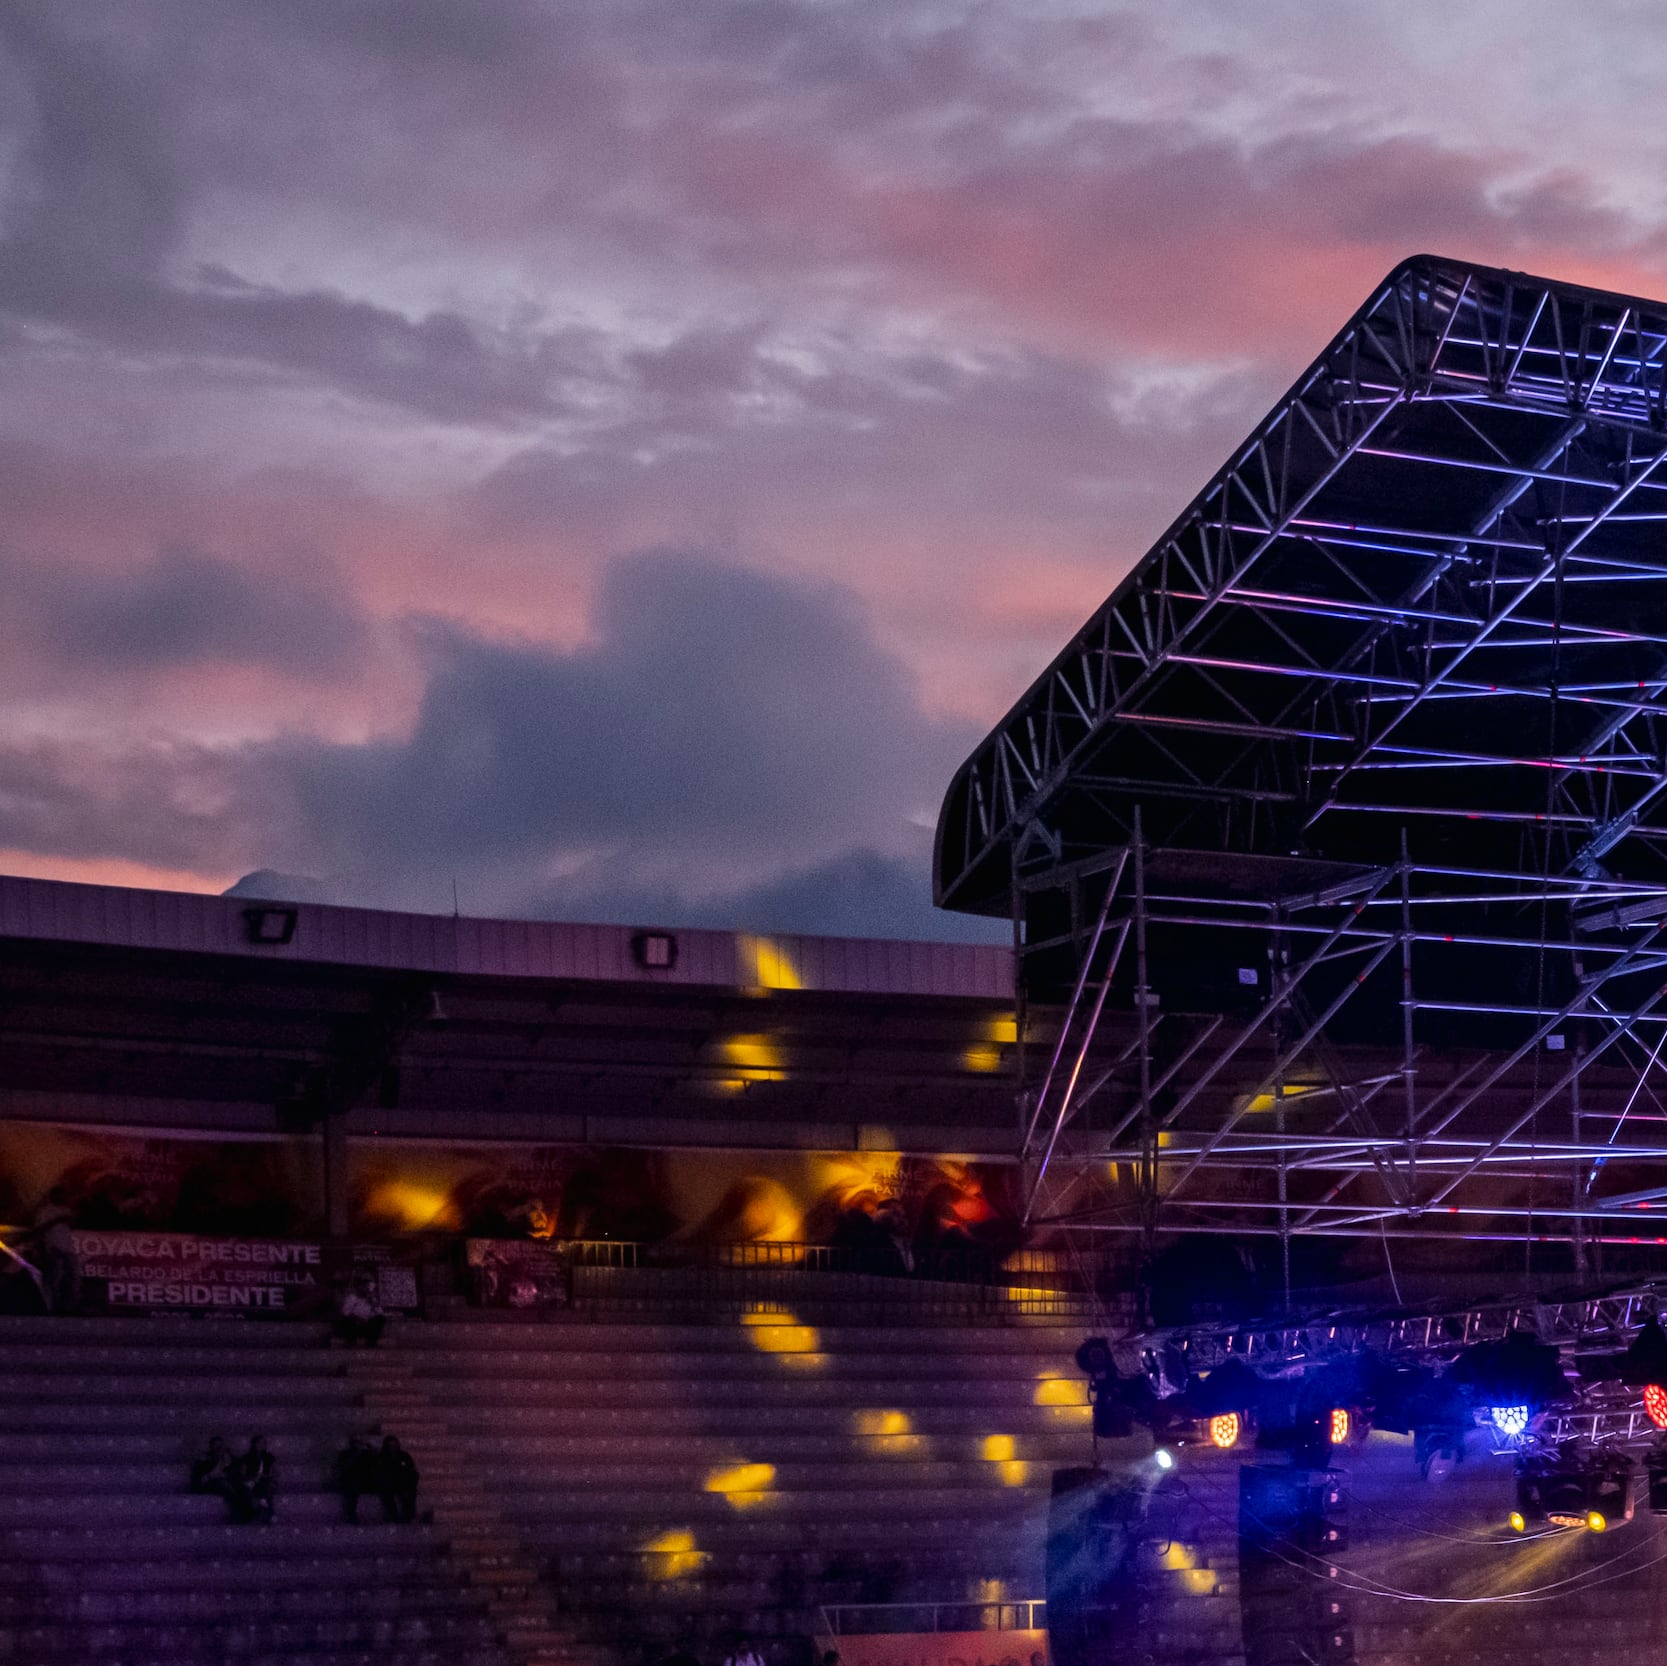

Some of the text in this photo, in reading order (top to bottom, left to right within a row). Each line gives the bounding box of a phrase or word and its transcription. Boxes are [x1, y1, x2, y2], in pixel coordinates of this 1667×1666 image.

[181, 1241, 322, 1265] PRESENTE
[224, 1270, 316, 1286] ESPRIELLA
[107, 1281, 286, 1307] PRESIDENTE
